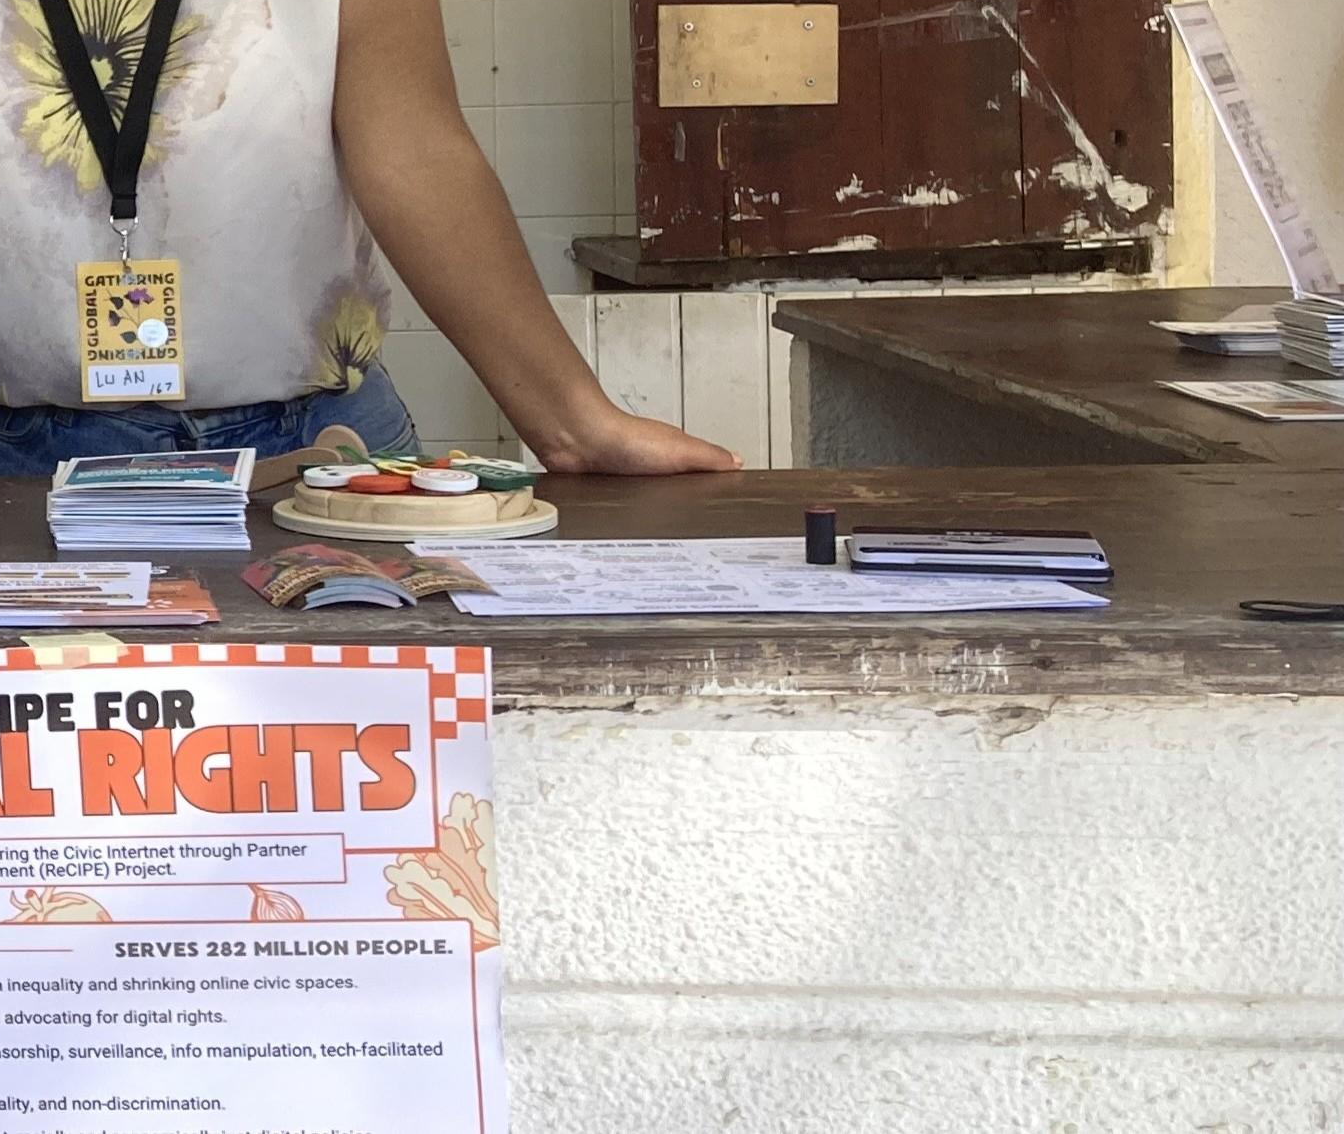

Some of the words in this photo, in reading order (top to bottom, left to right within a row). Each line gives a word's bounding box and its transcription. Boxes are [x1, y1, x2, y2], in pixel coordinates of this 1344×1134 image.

[86, 289, 98, 347] GLOBAL
[95, 371, 115, 388] LU
[123, 369, 145, 385] AN
[95, 690, 196, 731] FOR
[77, 723, 417, 816] RIGHTS
[33, 846, 59, 860] the
[64, 846, 102, 860] Civic
[179, 843, 242, 861] through
[247, 843, 308, 857] Partner
[39, 861, 110, 881] (ReCIPE)
[114, 862, 176, 879] Project.
[115, 942, 199, 958] SERVES
[206, 941, 246, 957] 282
[254, 940, 348, 956] MILLION
[356, 939, 453, 956] PEOPLE.
[8, 978, 83, 994] inequality
[88, 977, 118, 991] and
[122, 977, 195, 993] shrinking
[200, 976, 249, 990] online
[254, 976, 290, 989] civic
[296, 978, 358, 992] spaces.
[4, 1010, 92, 1027] advocating
[96, 1010, 118, 1024] for
[123, 1009, 172, 1027] digital
[177, 1009, 227, 1026] rights.
[68, 1044, 167, 1060] surveillance,
[171, 1043, 202, 1058] info
[206, 1043, 316, 1061] manipulation,
[320, 1041, 443, 1057] tech-facilitated
[38, 1096, 67, 1110] and
[72, 1096, 226, 1110] non-discrimination.
